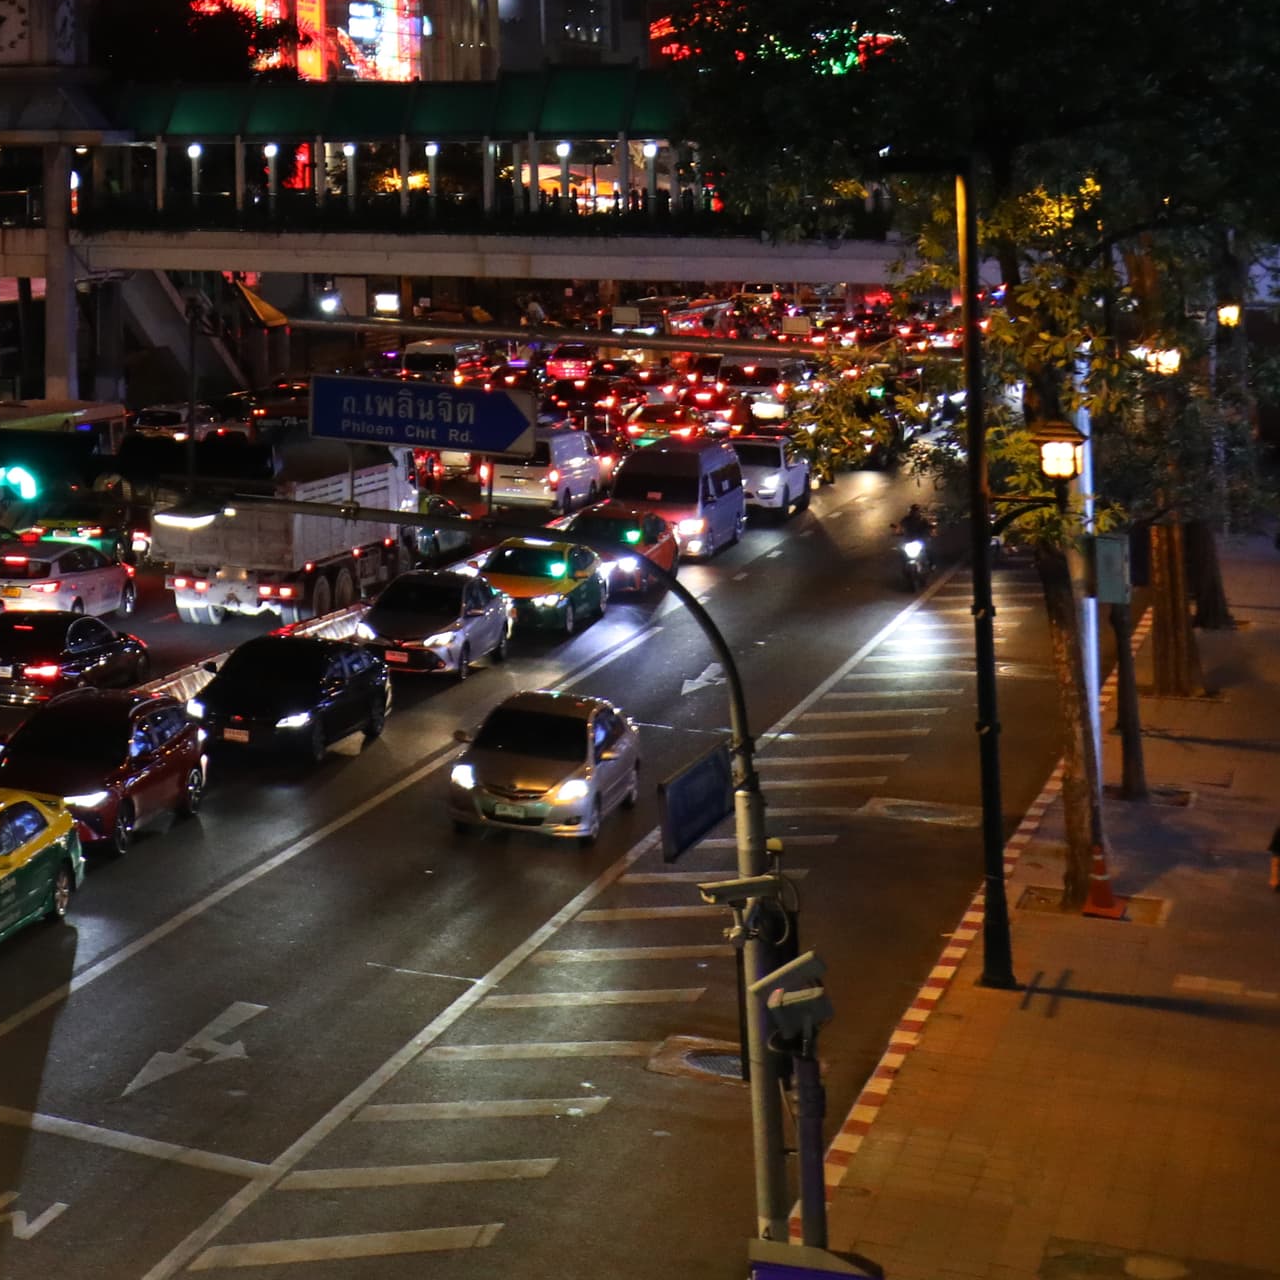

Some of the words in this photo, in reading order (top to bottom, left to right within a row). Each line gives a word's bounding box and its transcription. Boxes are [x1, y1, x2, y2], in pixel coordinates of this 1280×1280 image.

[342, 388, 475, 425] ถ.เพลินจิต
[341, 419, 394, 436] Phloen
[404, 424, 436, 440] Chit
[448, 429, 473, 443] Rd.
